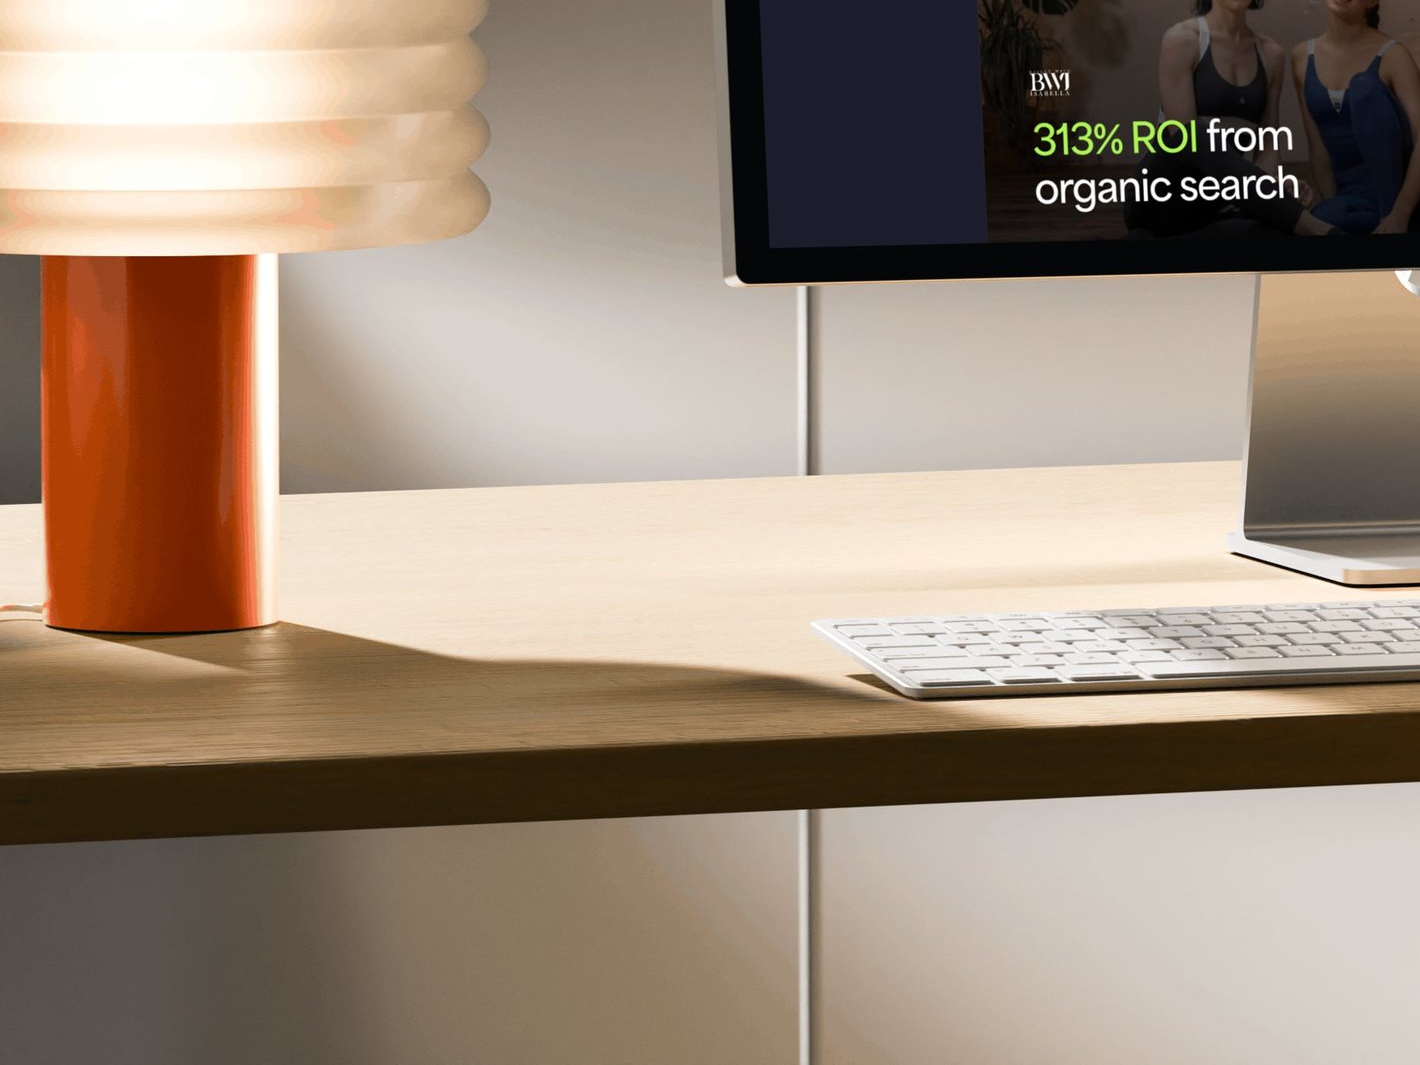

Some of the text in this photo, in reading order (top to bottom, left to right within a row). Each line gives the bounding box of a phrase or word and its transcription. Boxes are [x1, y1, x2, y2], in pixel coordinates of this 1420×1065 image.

[1034, 118, 1292, 156] 313% ROI from
[1036, 166, 1299, 212] organic search
